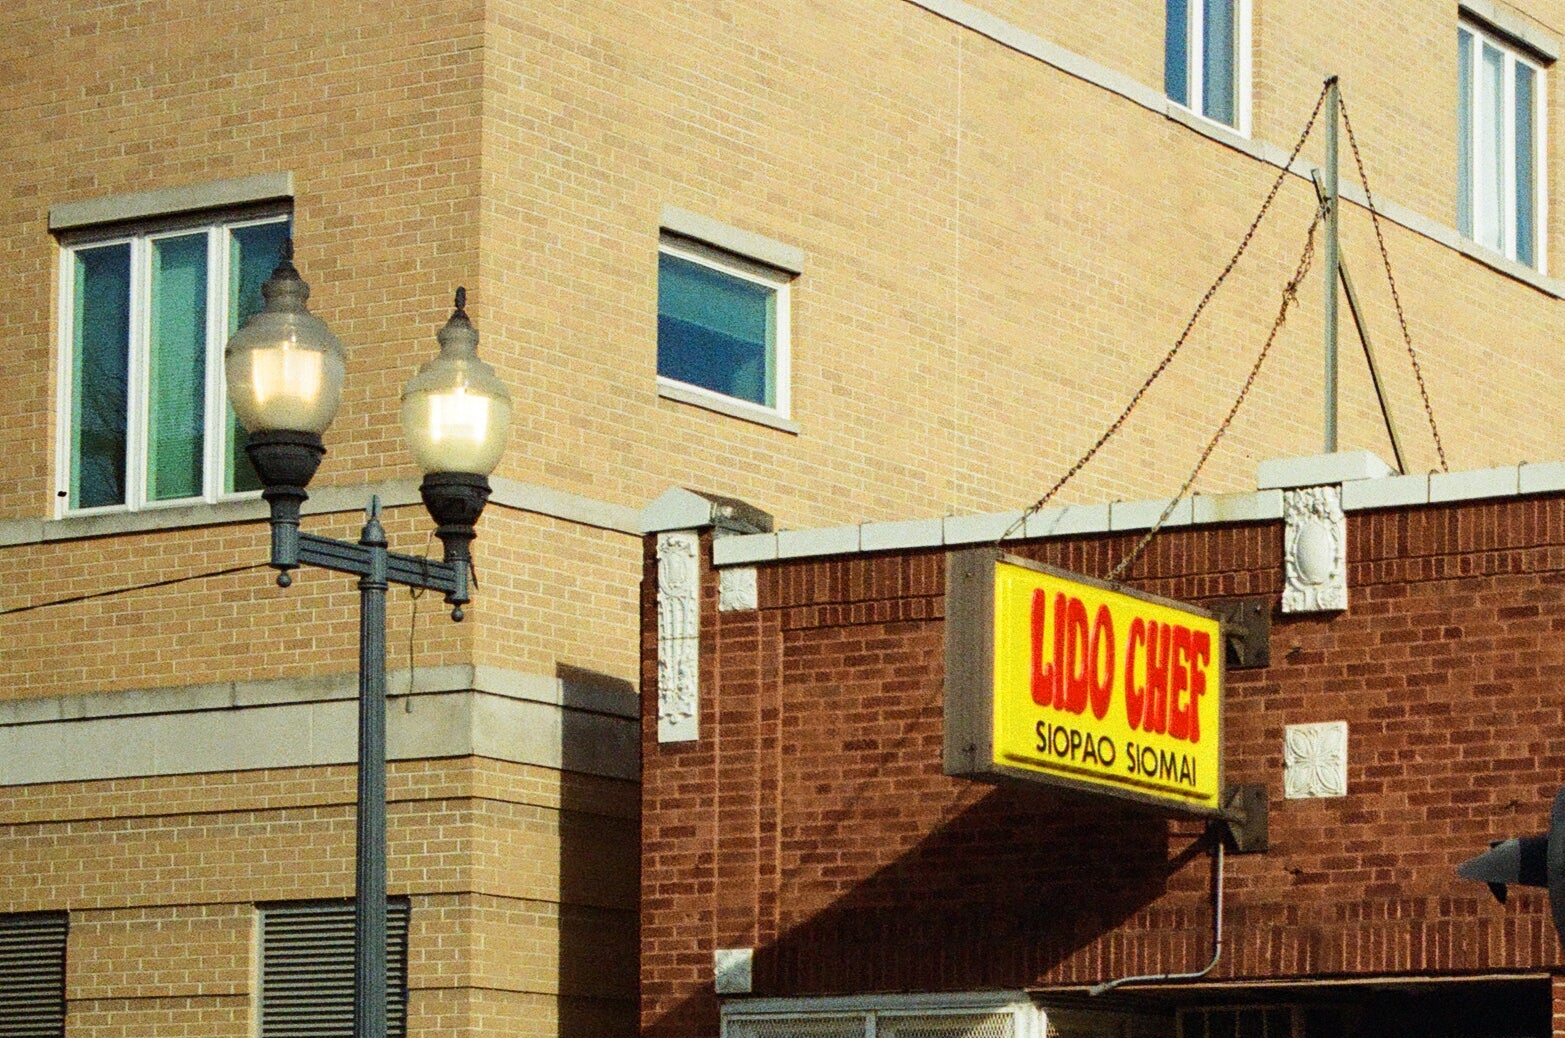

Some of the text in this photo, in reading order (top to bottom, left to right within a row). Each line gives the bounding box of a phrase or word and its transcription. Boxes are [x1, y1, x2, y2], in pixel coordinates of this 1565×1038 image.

[1030, 587, 1210, 743] LIDO CHEF
[1035, 720, 1196, 786] SIOPAO SIOMAI
